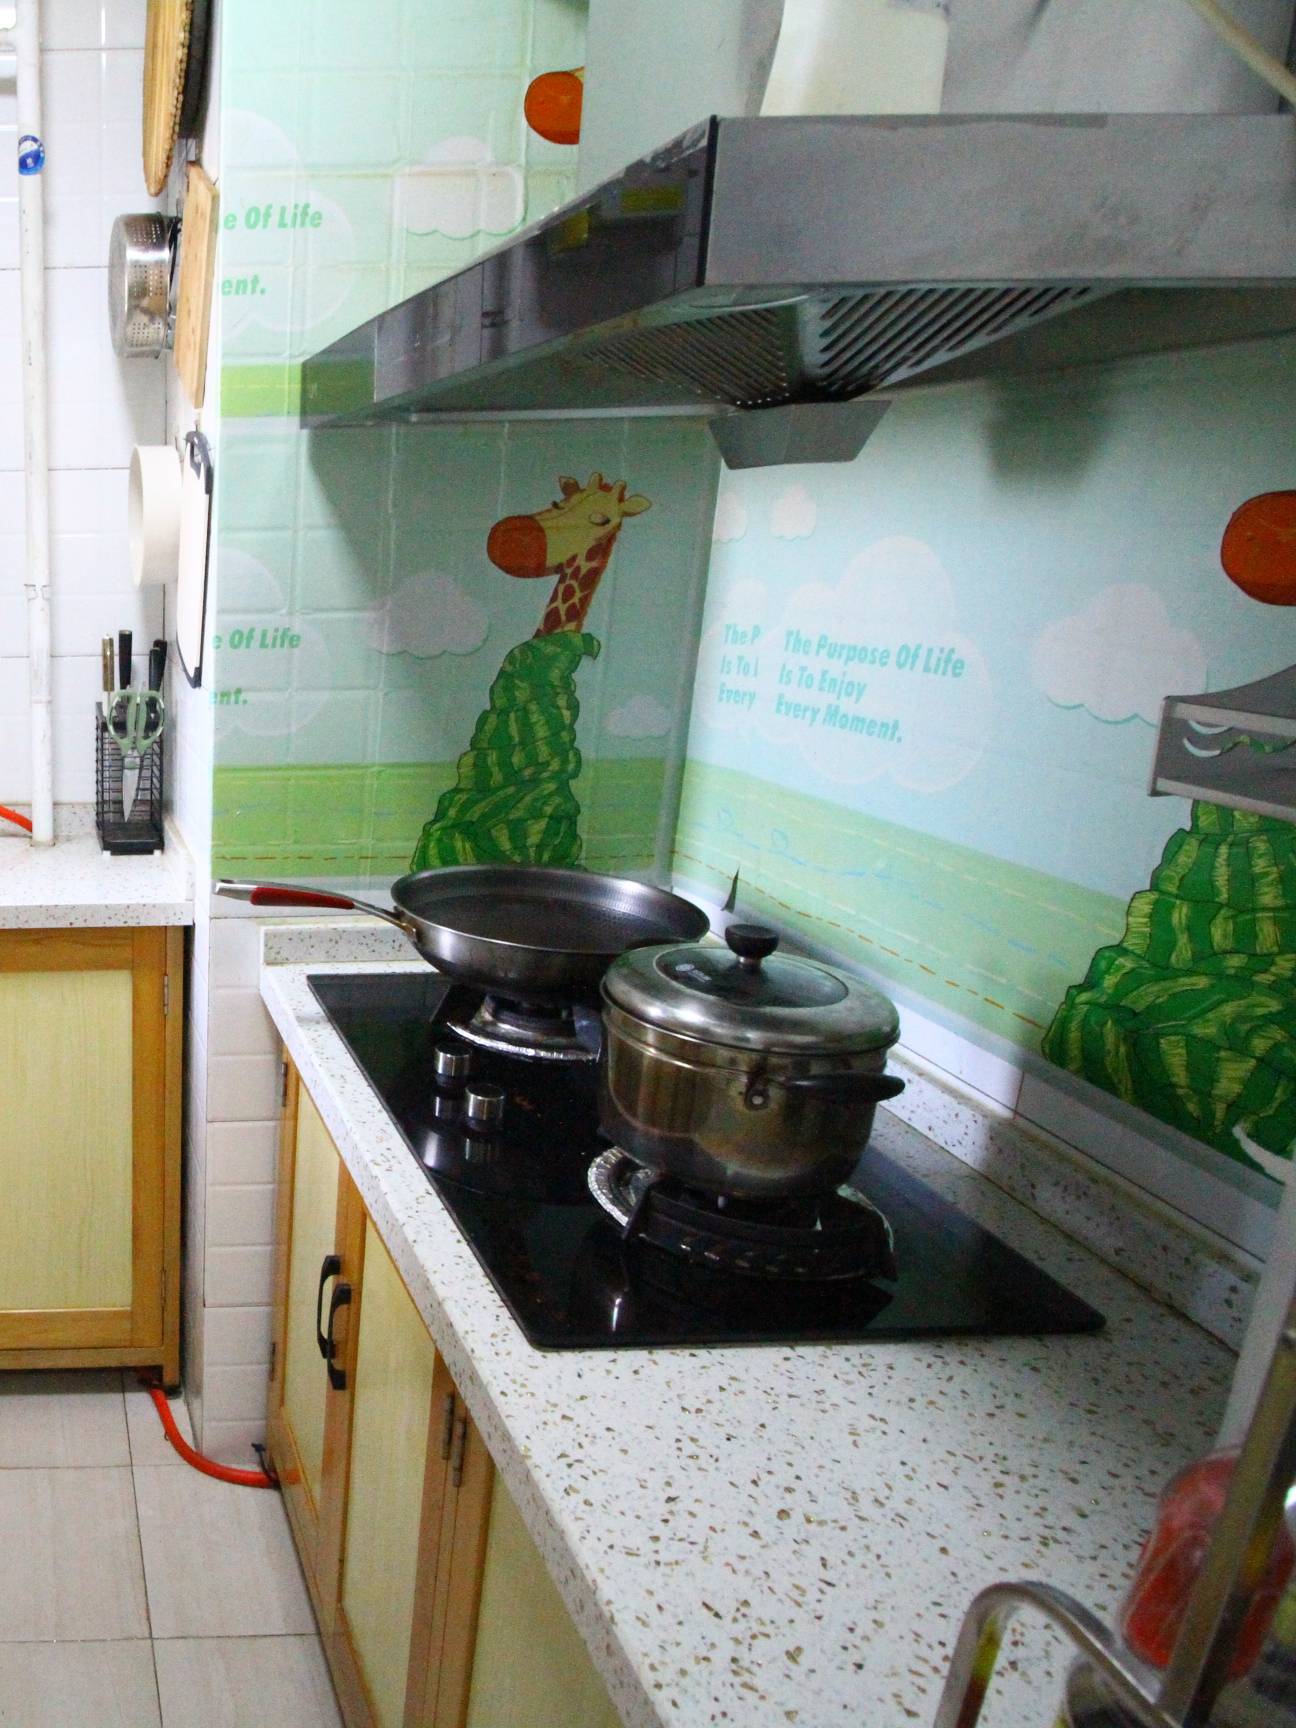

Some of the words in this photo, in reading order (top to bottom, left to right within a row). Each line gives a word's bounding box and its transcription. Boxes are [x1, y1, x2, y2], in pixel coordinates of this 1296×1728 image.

[245, 203, 273, 230] Of
[277, 202, 323, 229] Life
[221, 274, 267, 296] ent.
[228, 627, 255, 650] Of
[259, 627, 302, 649] Life
[723, 623, 748, 645] The
[719, 654, 732, 674] Is
[736, 655, 750, 676] To
[783, 629, 811, 656] The
[815, 634, 891, 668] Purpose
[895, 643, 922, 671] Of
[922, 646, 966, 678] Life
[718, 681, 757, 711] Every
[778, 663, 793, 686] Is
[797, 666, 814, 690] To
[817, 669, 868, 705] Enjoy
[775, 693, 821, 727] Every
[822, 704, 903, 744] Moment.
